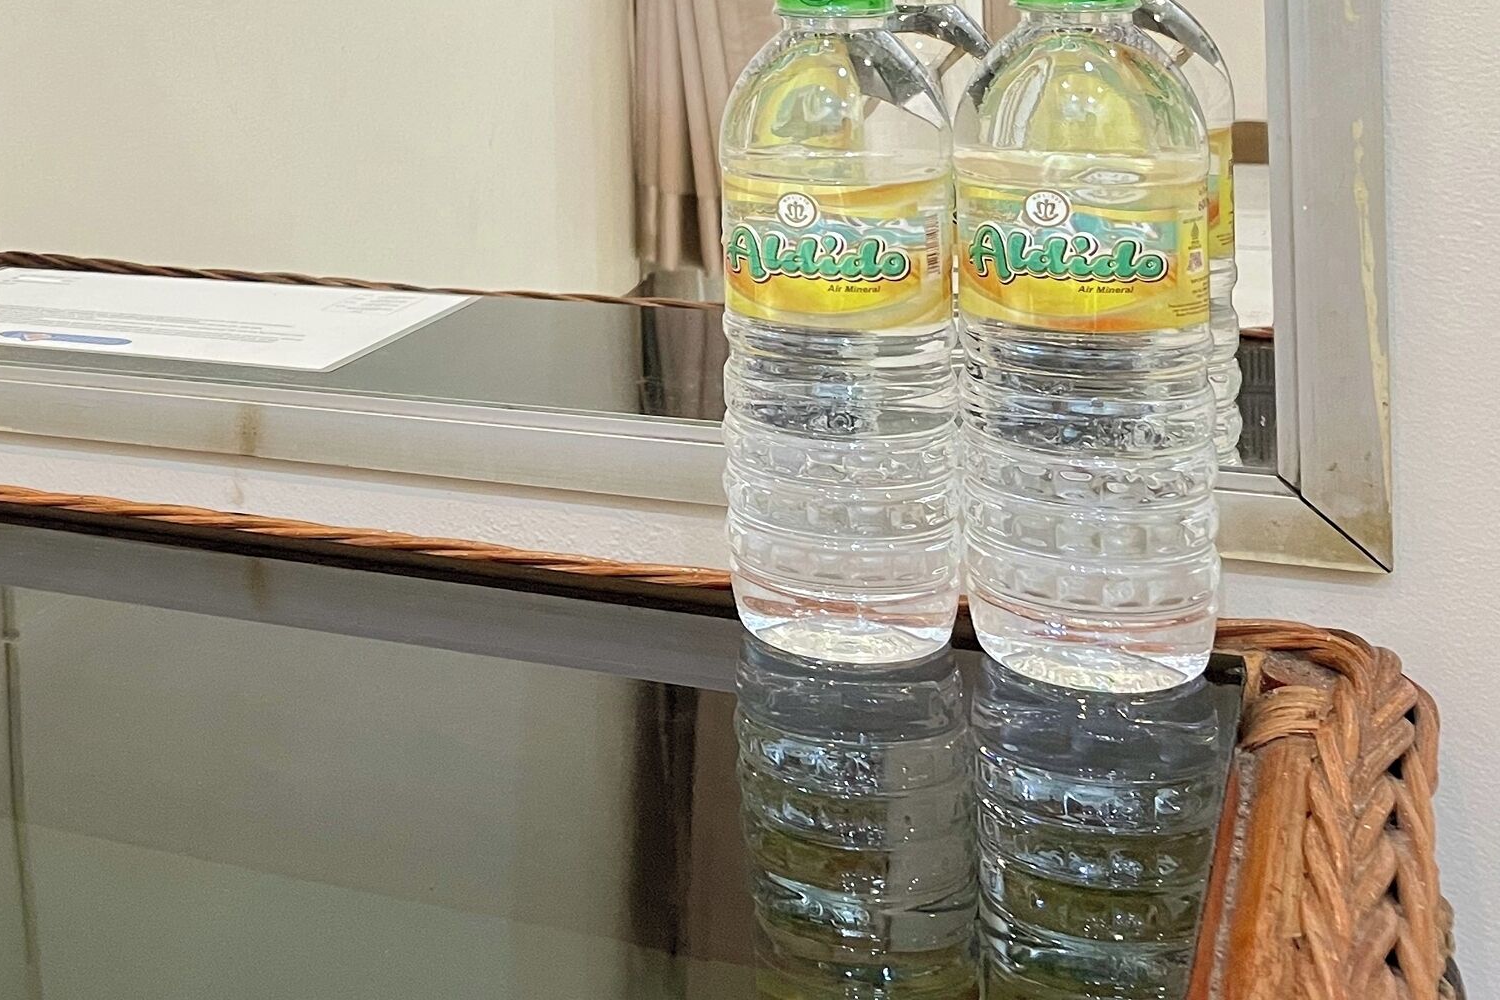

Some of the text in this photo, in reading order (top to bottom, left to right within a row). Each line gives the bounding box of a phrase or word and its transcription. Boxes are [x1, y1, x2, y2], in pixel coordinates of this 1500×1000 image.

[727, 226, 911, 283] Aldido
[968, 223, 1169, 284] Aldido
[827, 284, 881, 294] Air Mineral
[1077, 286, 1134, 294] Air Mineral
